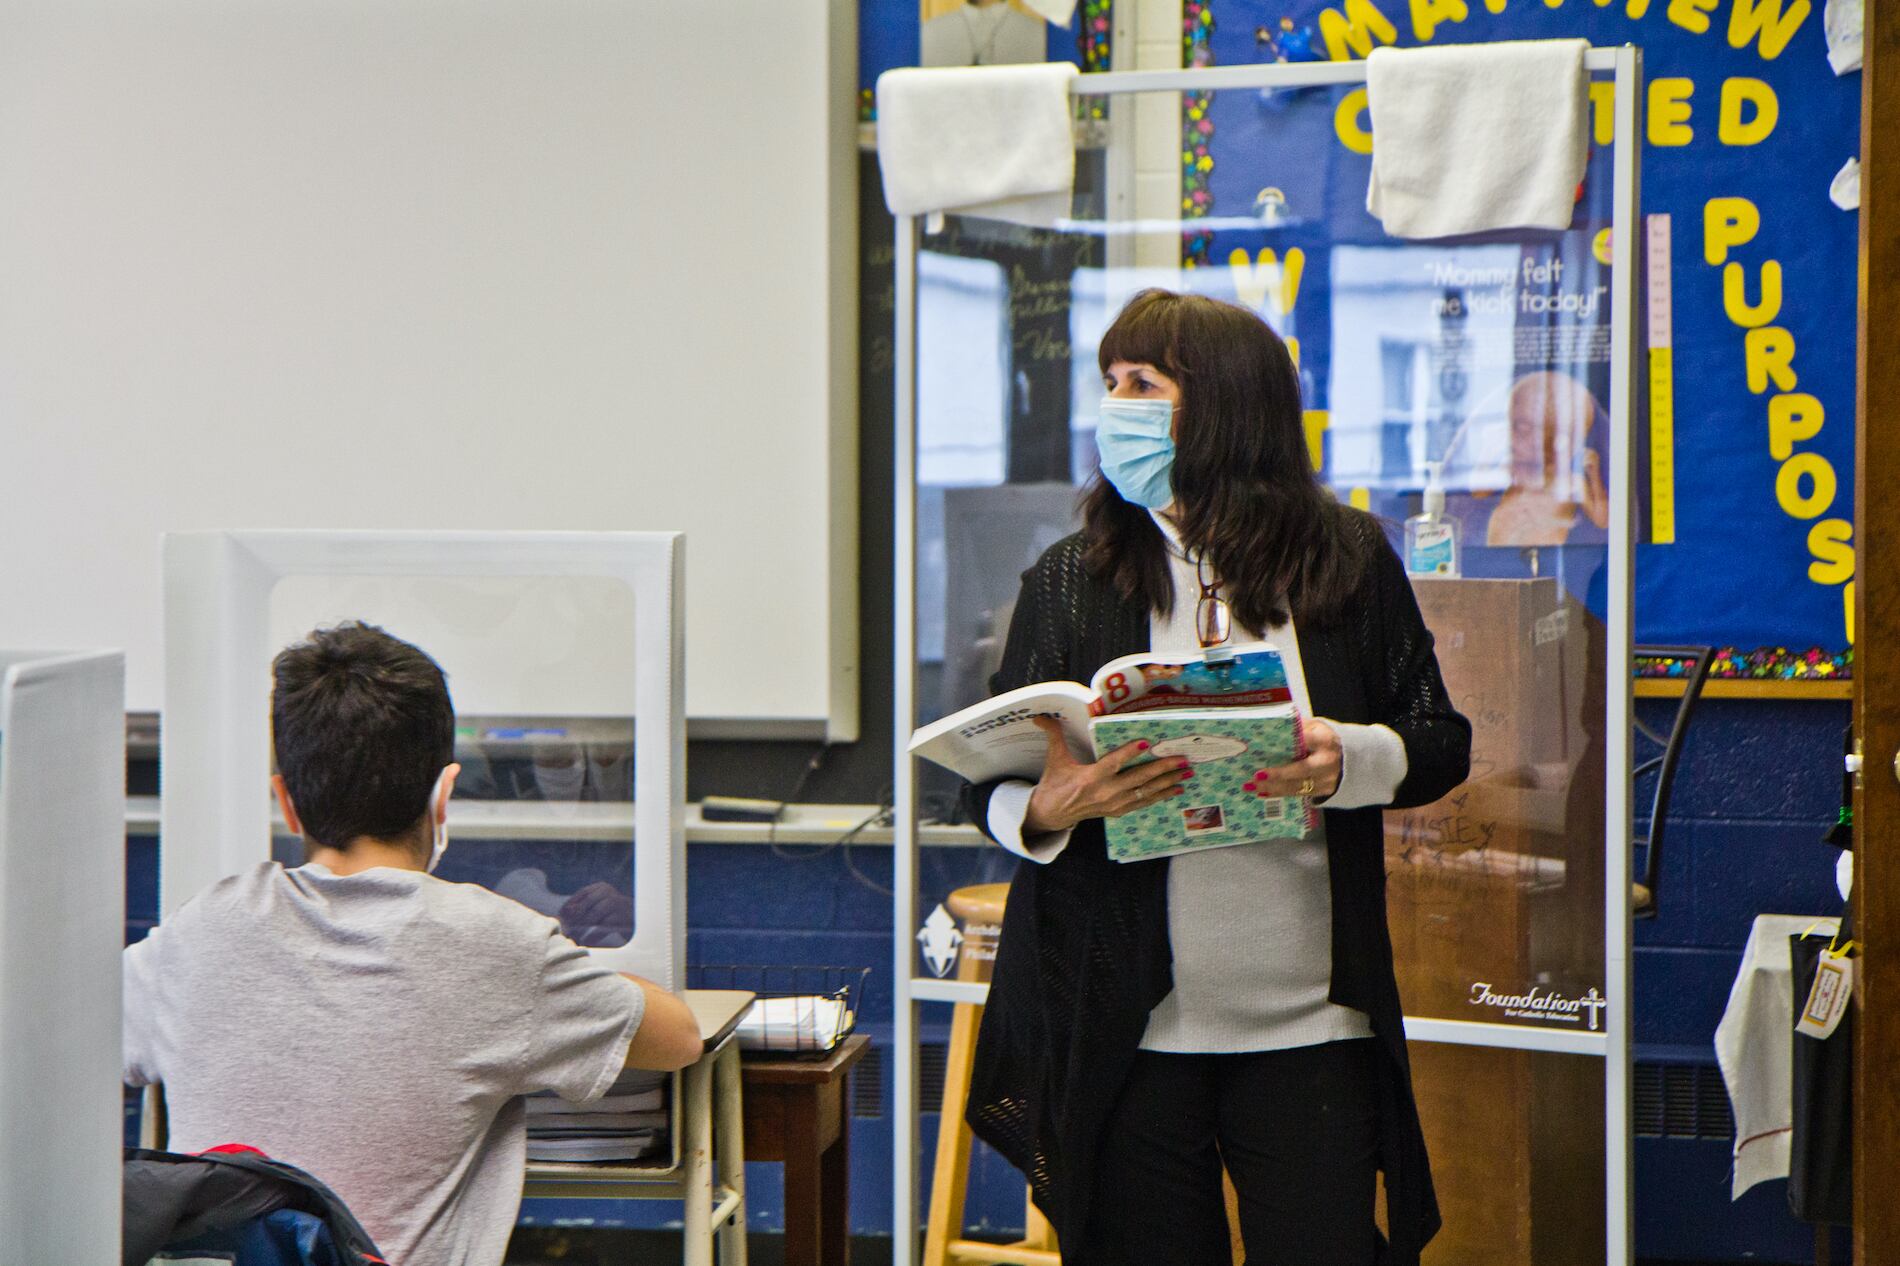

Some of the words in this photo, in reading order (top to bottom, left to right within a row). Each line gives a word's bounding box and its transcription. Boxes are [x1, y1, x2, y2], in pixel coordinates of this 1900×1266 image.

[1522, 256, 1564, 285] felt
[1105, 672, 1131, 703] 8
[1469, 982, 1580, 1012] Foundation
